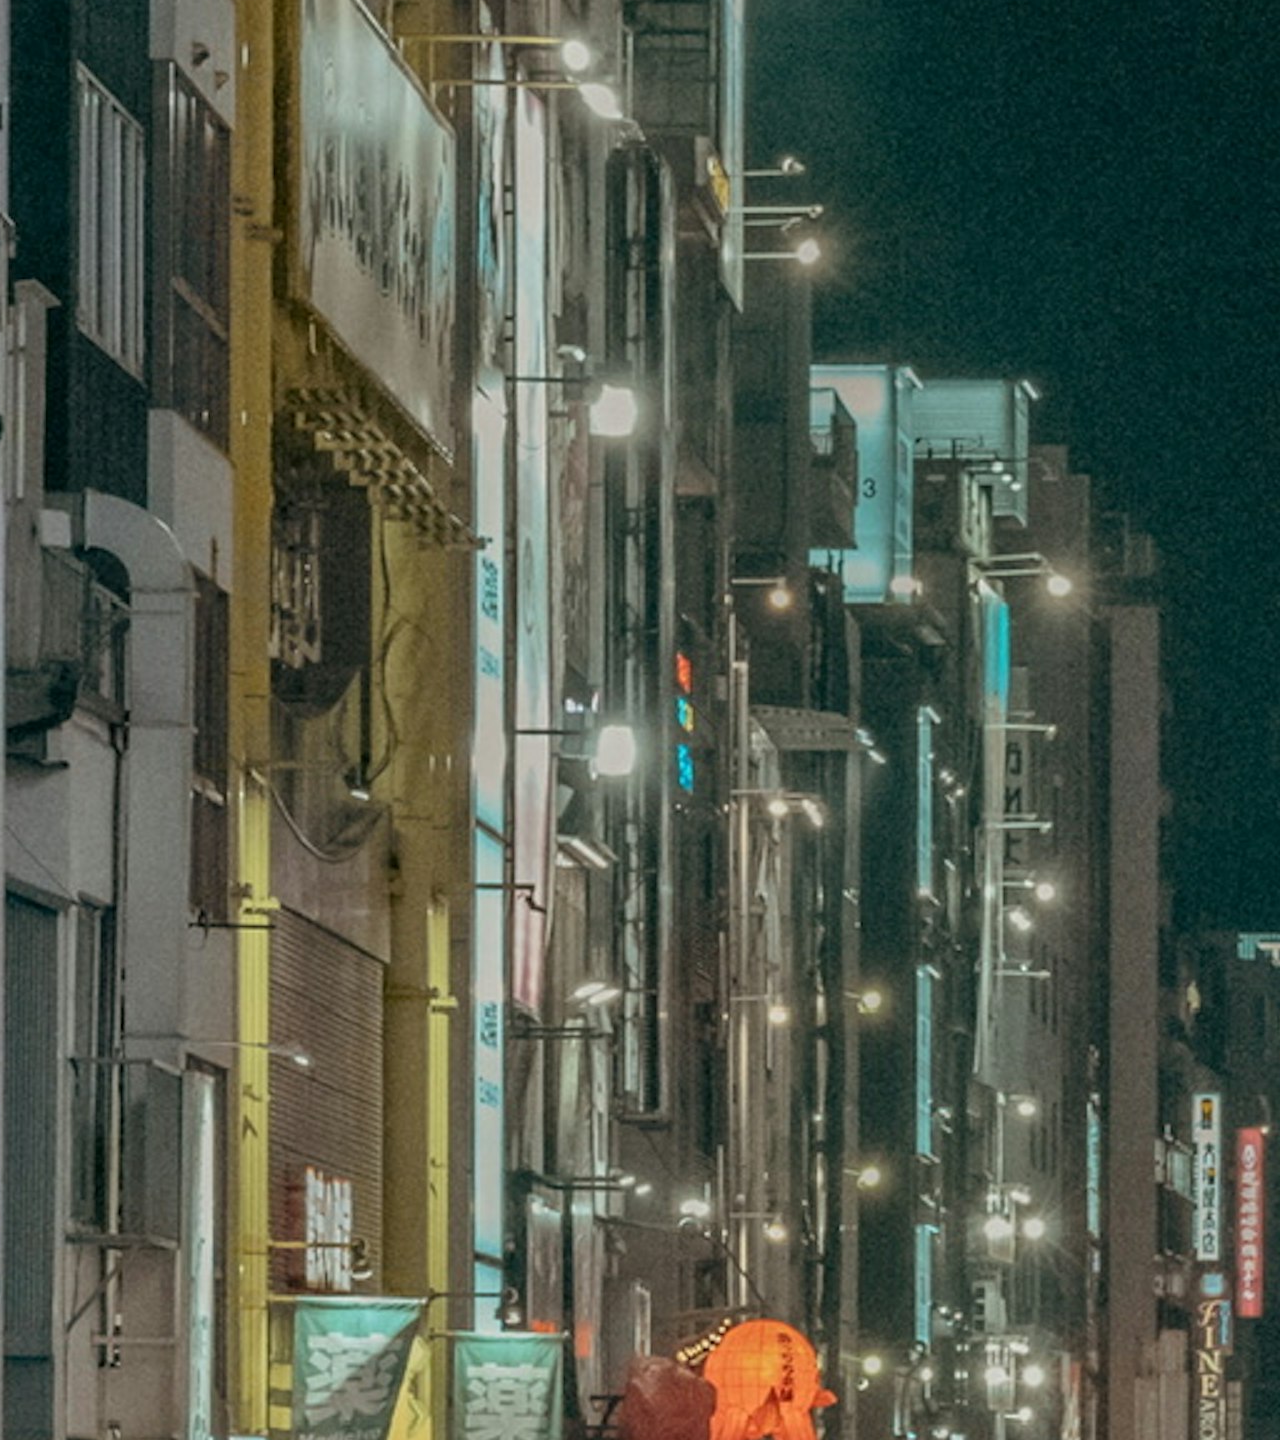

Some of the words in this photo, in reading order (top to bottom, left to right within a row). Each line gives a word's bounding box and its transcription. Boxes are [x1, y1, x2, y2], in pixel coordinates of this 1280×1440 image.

[861, 477, 877, 499] 3
[304, 1332, 401, 1427] 薬
[1197, 1299, 1222, 1398] FINE
